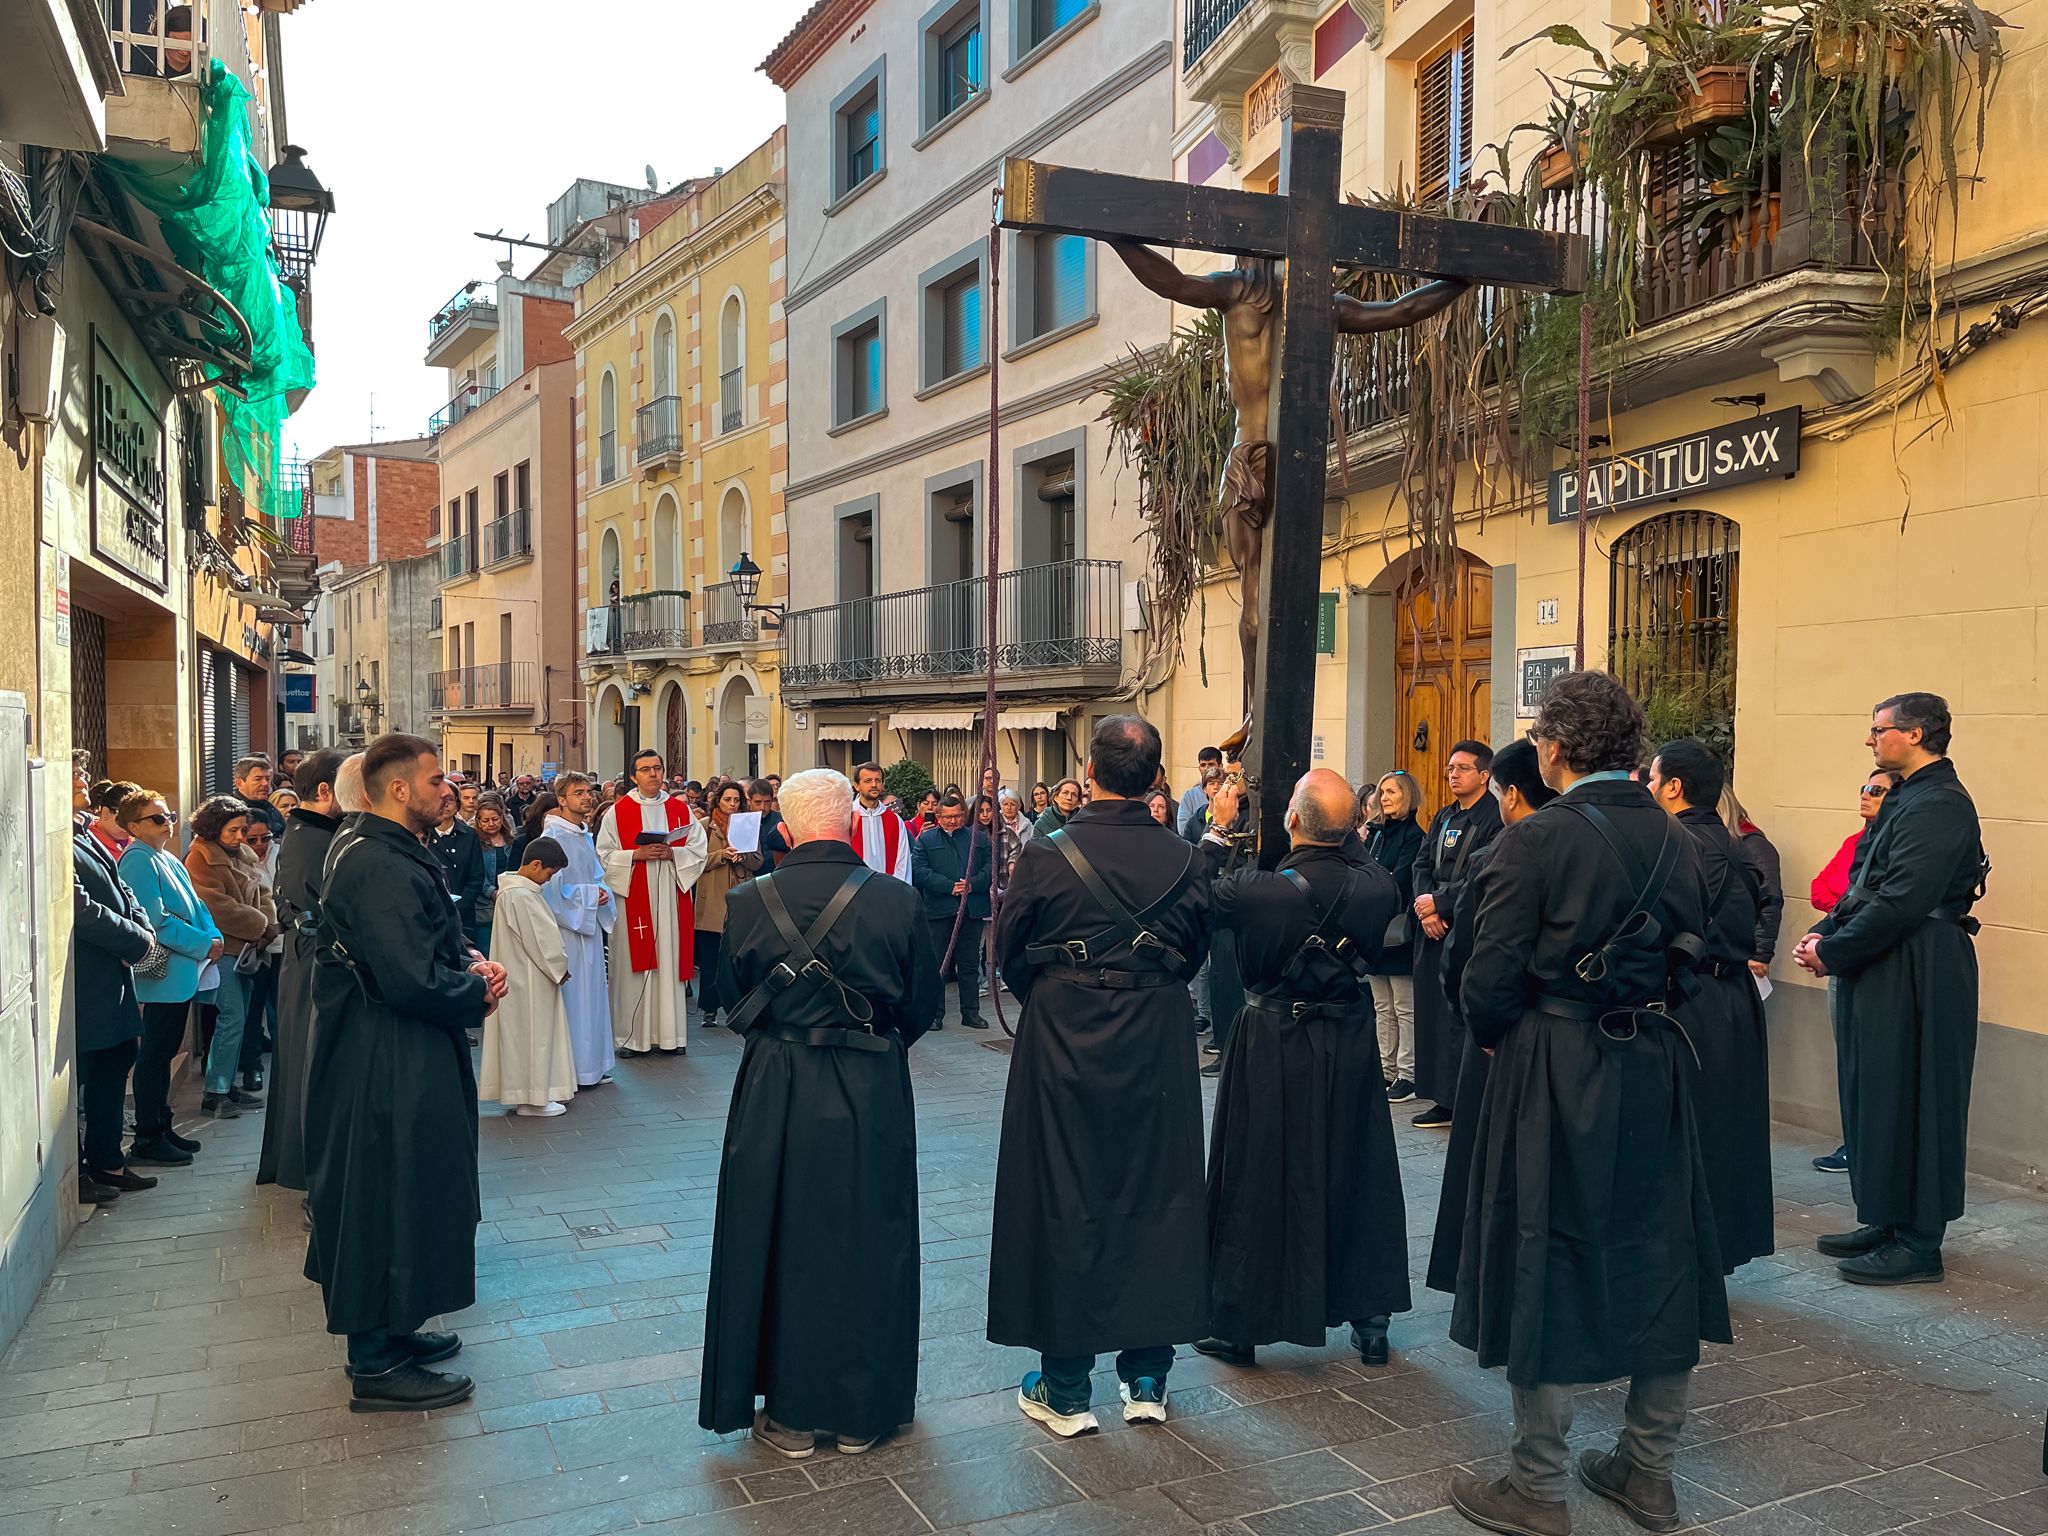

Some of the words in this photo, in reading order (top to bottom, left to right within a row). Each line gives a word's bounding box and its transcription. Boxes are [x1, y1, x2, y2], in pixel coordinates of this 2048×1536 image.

[1560, 440, 1705, 513] PAPITU
[1714, 426, 1780, 475] S.XX
[1541, 604, 1554, 620] 14
